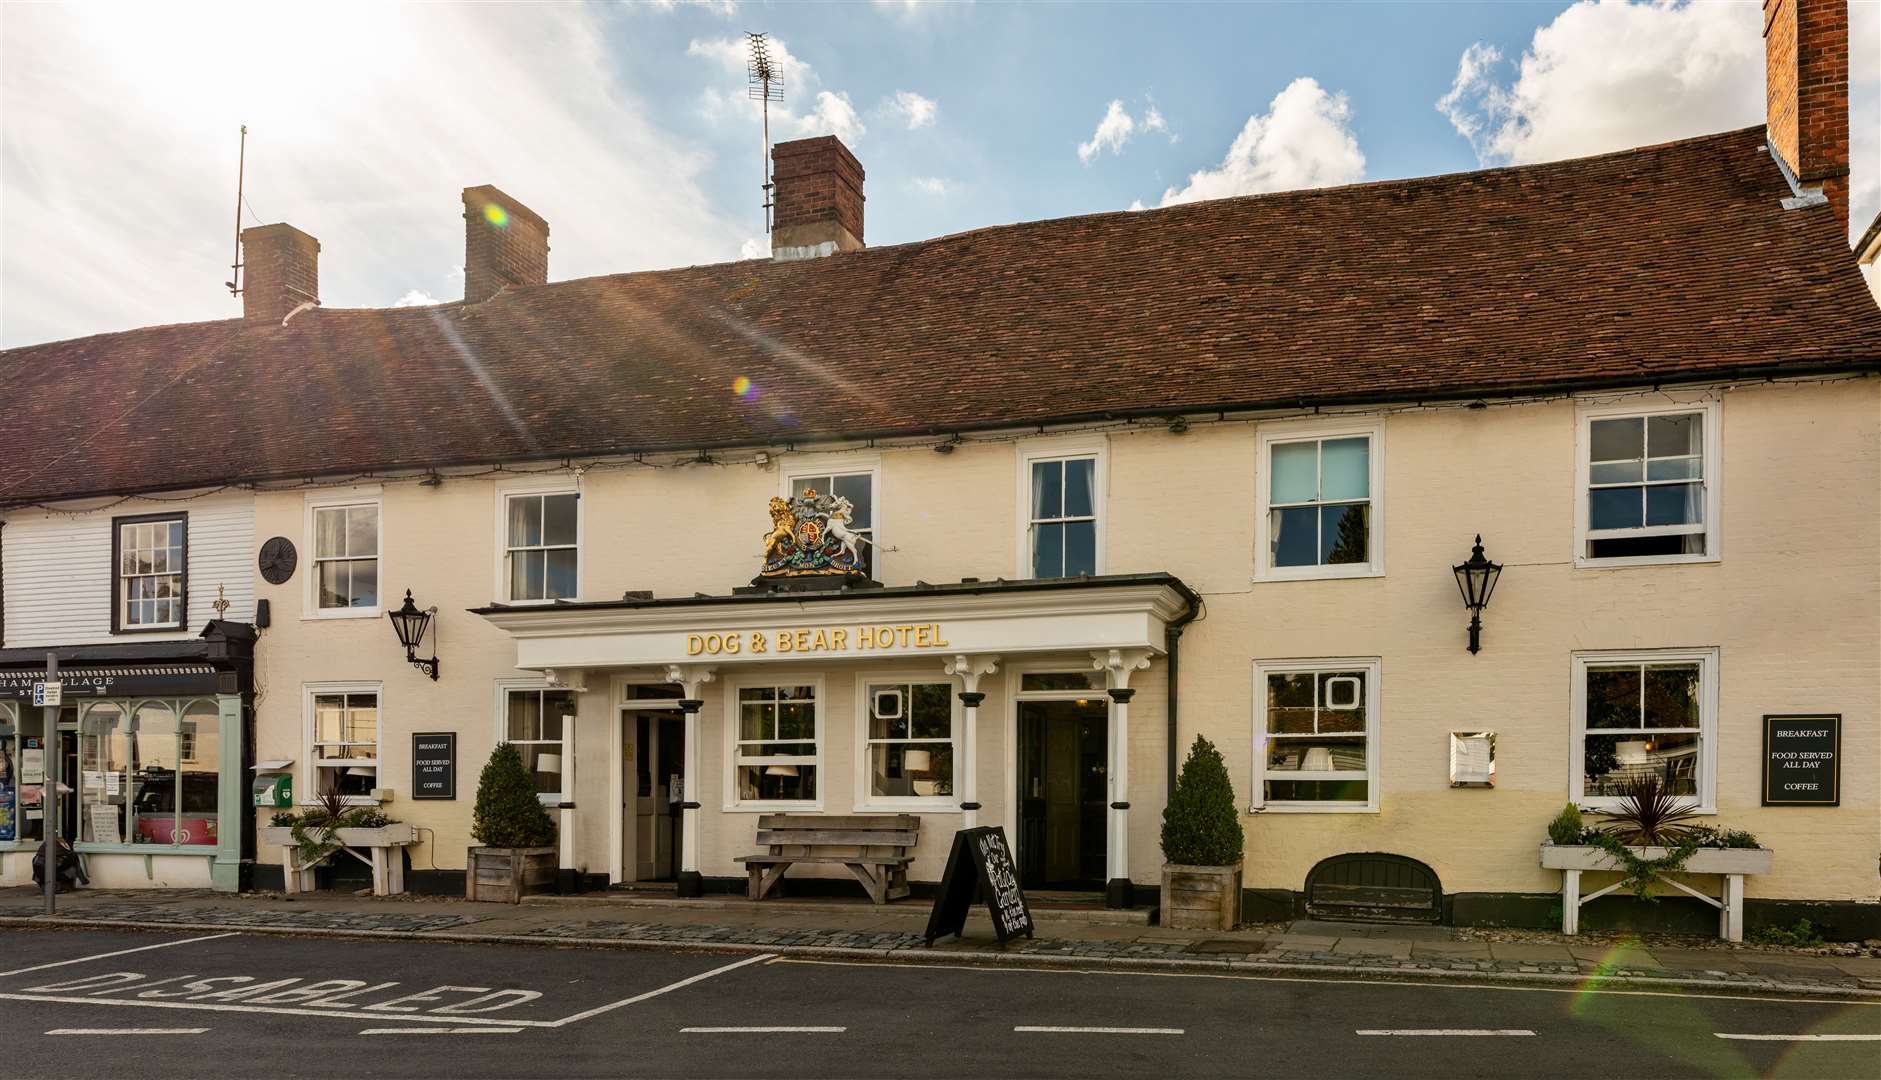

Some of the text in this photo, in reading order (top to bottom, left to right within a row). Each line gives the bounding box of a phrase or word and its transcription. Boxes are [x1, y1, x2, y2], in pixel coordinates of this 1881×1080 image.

[687, 623, 949, 656] DOG & BEAR HOTEL
[1777, 730, 1829, 738] BREAKFAST
[1771, 752, 1833, 760] FOOD SERVED
[1784, 783, 1819, 791] COFFEE
[21, 972, 543, 1014] DISABLED
